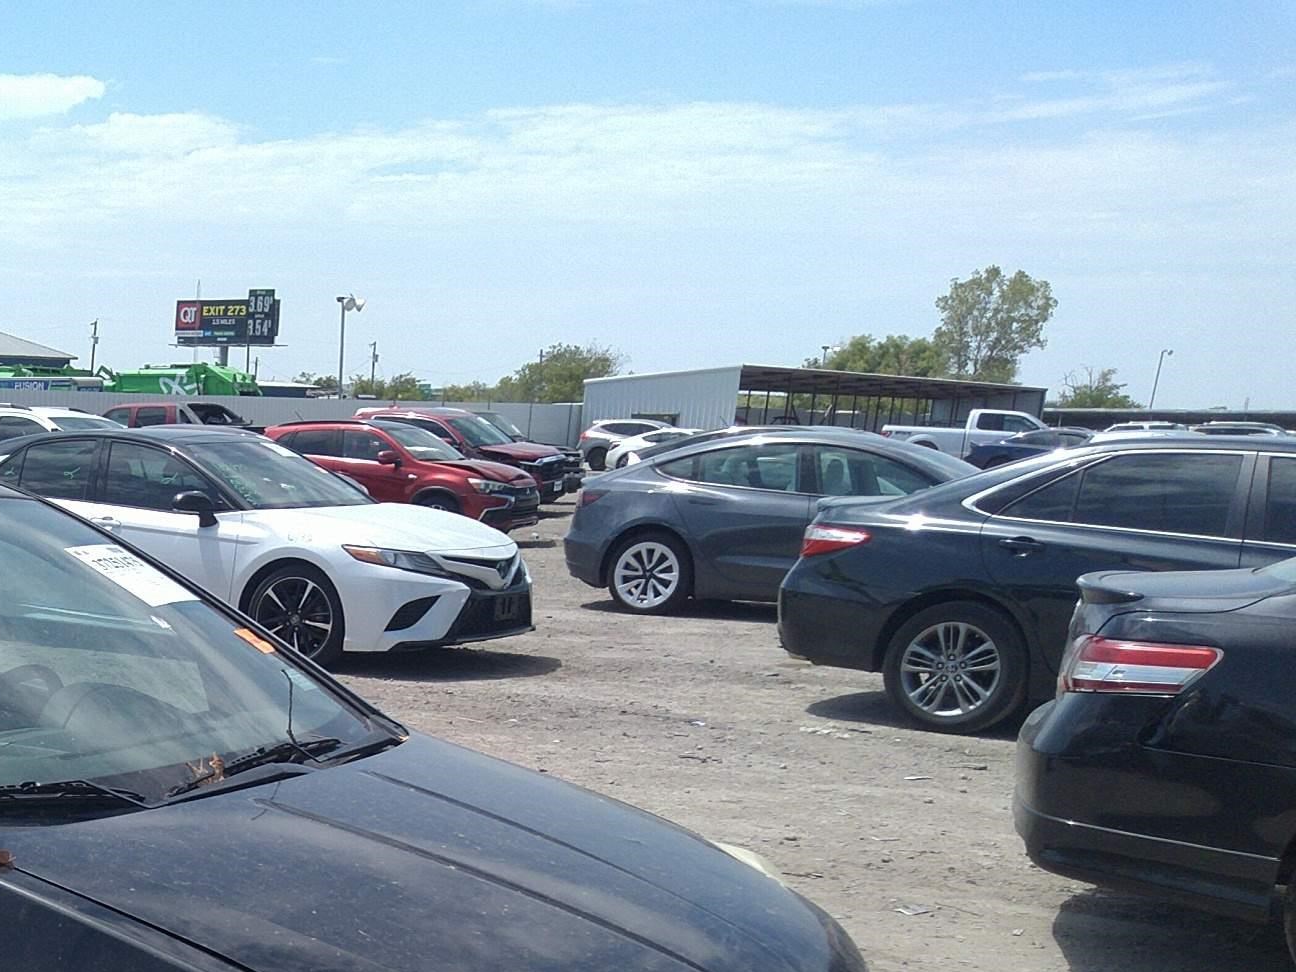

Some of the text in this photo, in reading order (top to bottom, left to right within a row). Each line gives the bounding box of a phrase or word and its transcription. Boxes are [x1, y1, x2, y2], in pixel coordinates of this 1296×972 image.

[180, 307, 197, 323] QT
[202, 305, 246, 316] EXIT 273
[14, 382, 45, 391] FUSION
